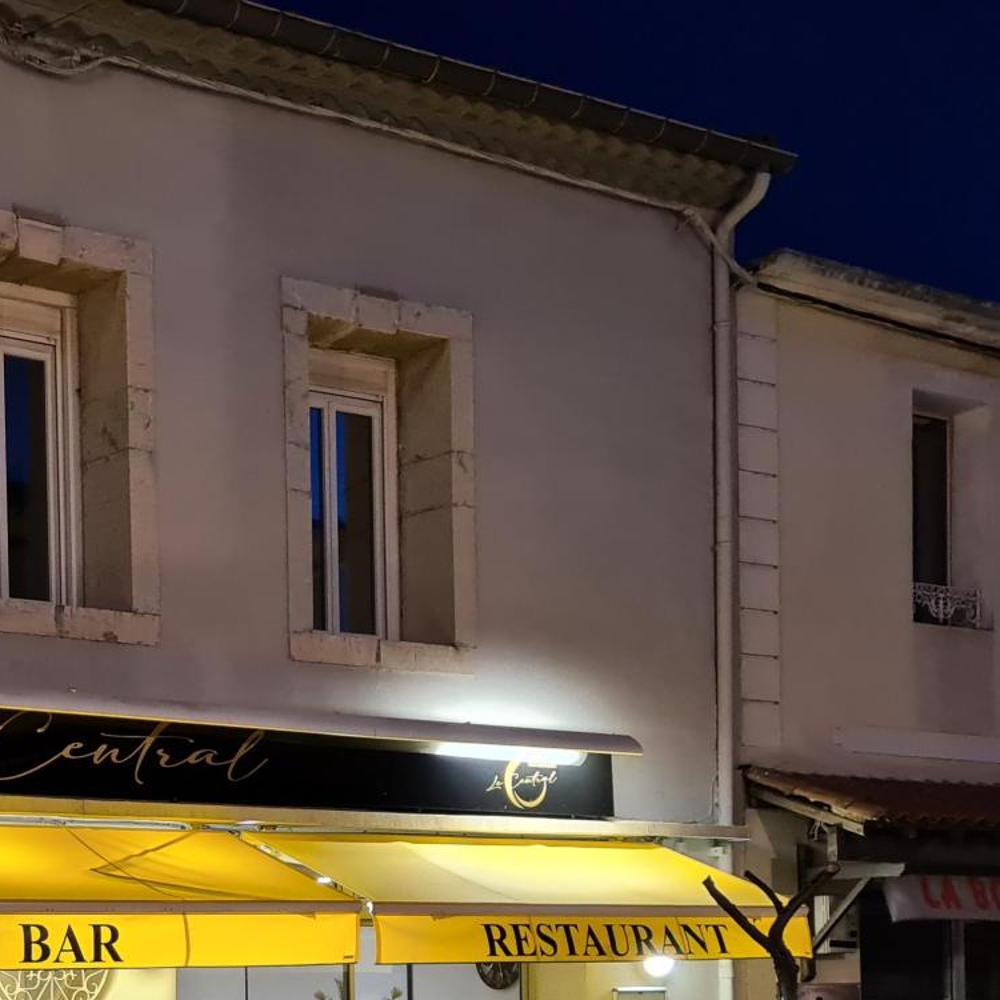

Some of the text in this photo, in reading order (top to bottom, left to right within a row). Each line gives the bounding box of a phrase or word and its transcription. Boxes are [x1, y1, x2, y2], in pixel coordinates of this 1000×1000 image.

[485, 774, 504, 792] Le
[18, 923, 124, 963] BAR
[482, 922, 730, 958] RESTAURANT
